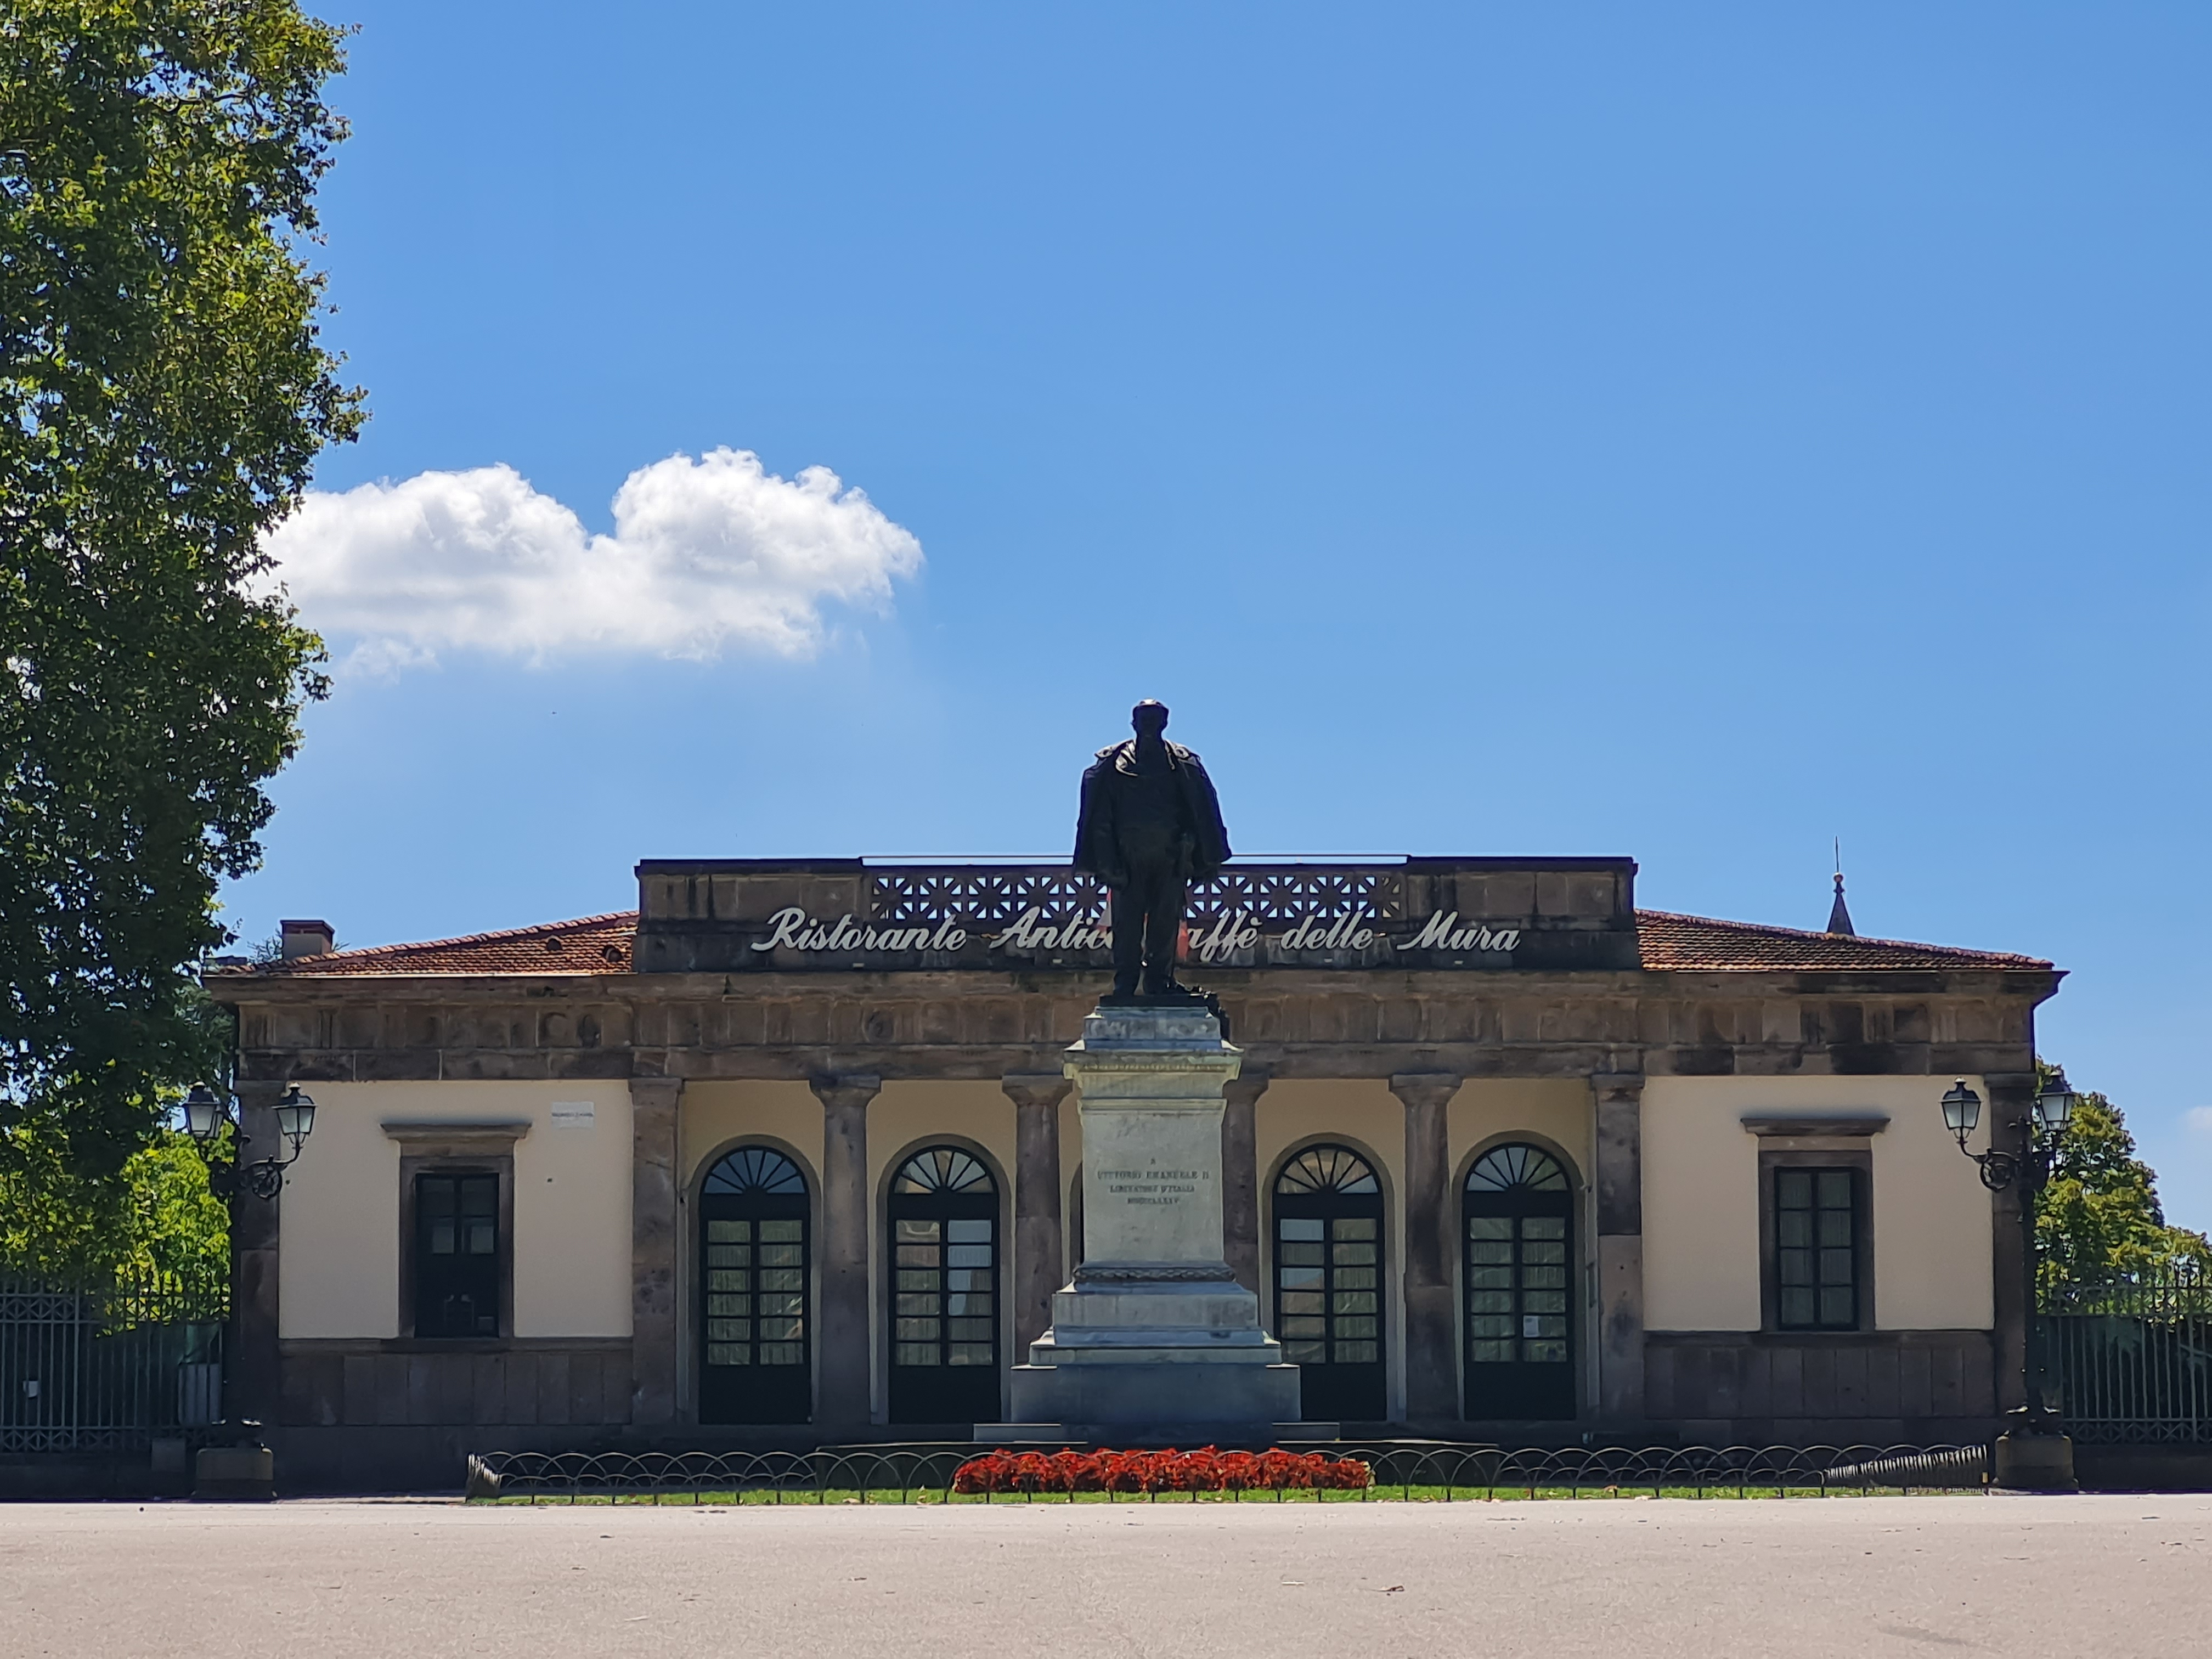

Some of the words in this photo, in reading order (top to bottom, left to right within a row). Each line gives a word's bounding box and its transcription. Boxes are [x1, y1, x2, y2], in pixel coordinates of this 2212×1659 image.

[751, 907, 967, 951] Ristorante
[1280, 911, 1373, 950] delle
[1397, 910, 1521, 951] Mura
